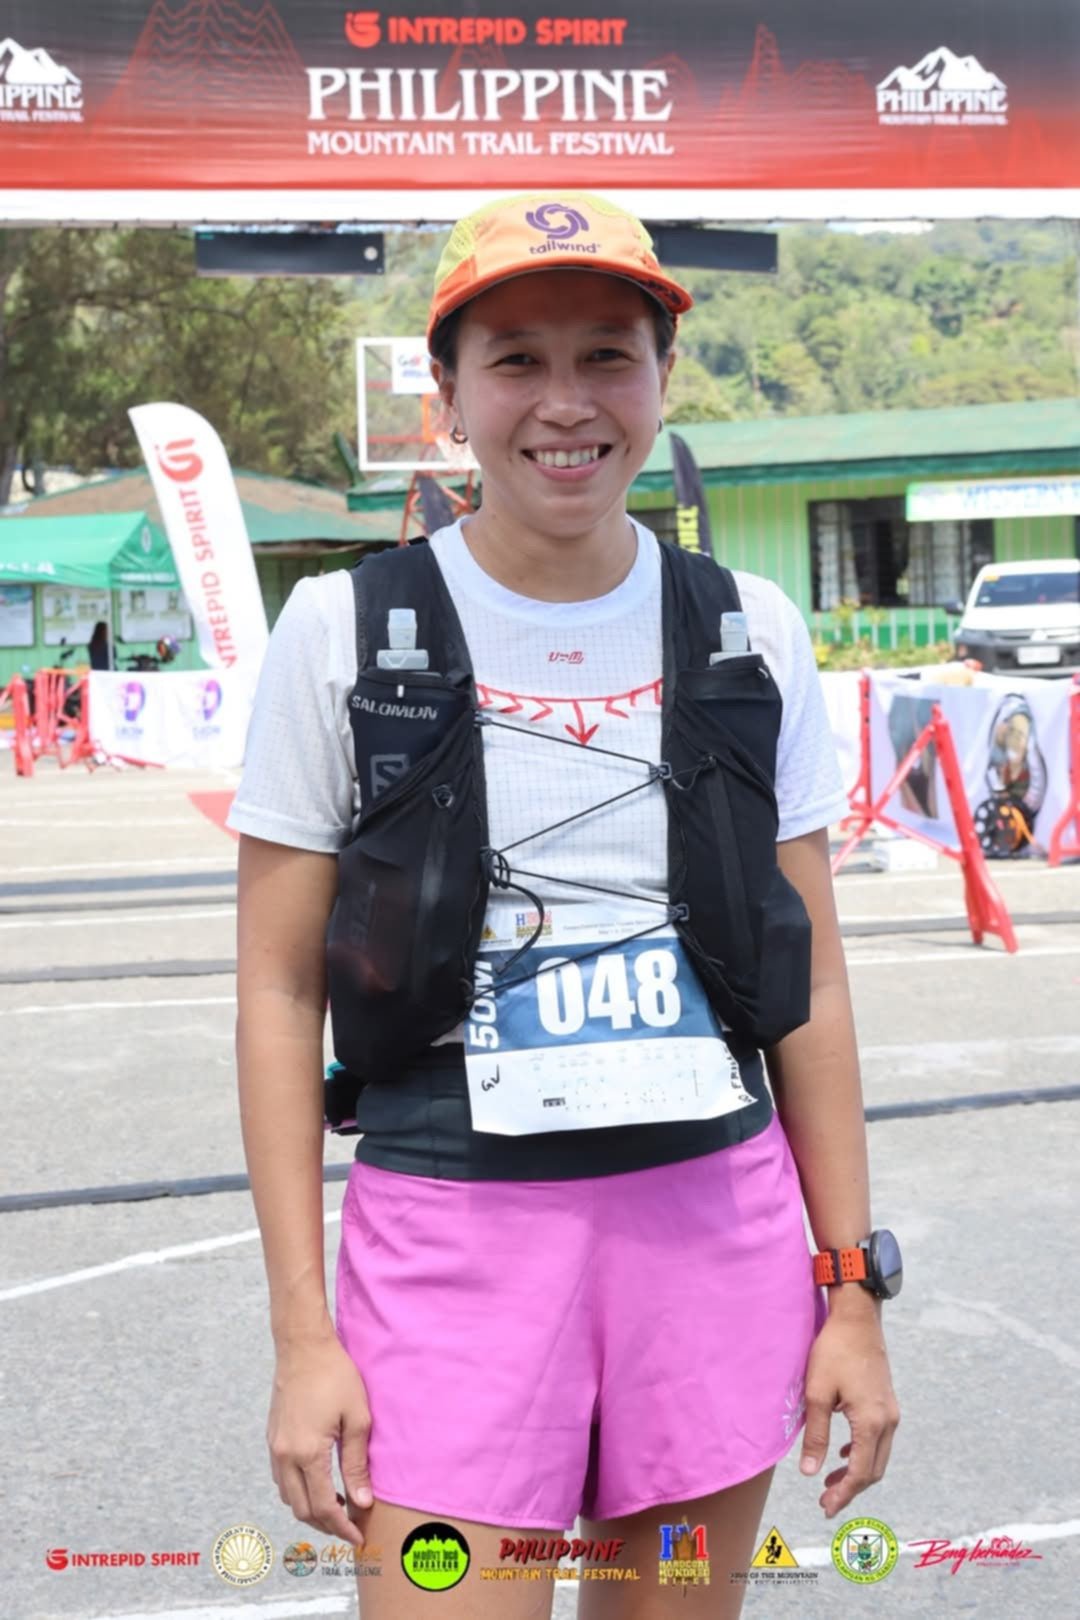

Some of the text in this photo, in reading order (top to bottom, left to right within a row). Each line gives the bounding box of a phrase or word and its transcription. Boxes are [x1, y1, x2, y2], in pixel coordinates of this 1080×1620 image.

[388, 17, 627, 45] INTREPID SPIRIT
[305, 67, 673, 121] PHILIPPINE
[877, 90, 1008, 113] PHILIPPINE
[308, 131, 674, 155] MOUNTAIN TRAIL FESTIVAL
[529, 240, 598, 255] tailwind
[178, 487, 215, 562] SPIRIT
[351, 695, 438, 720] SALOMON
[536, 950, 682, 1036] 048
